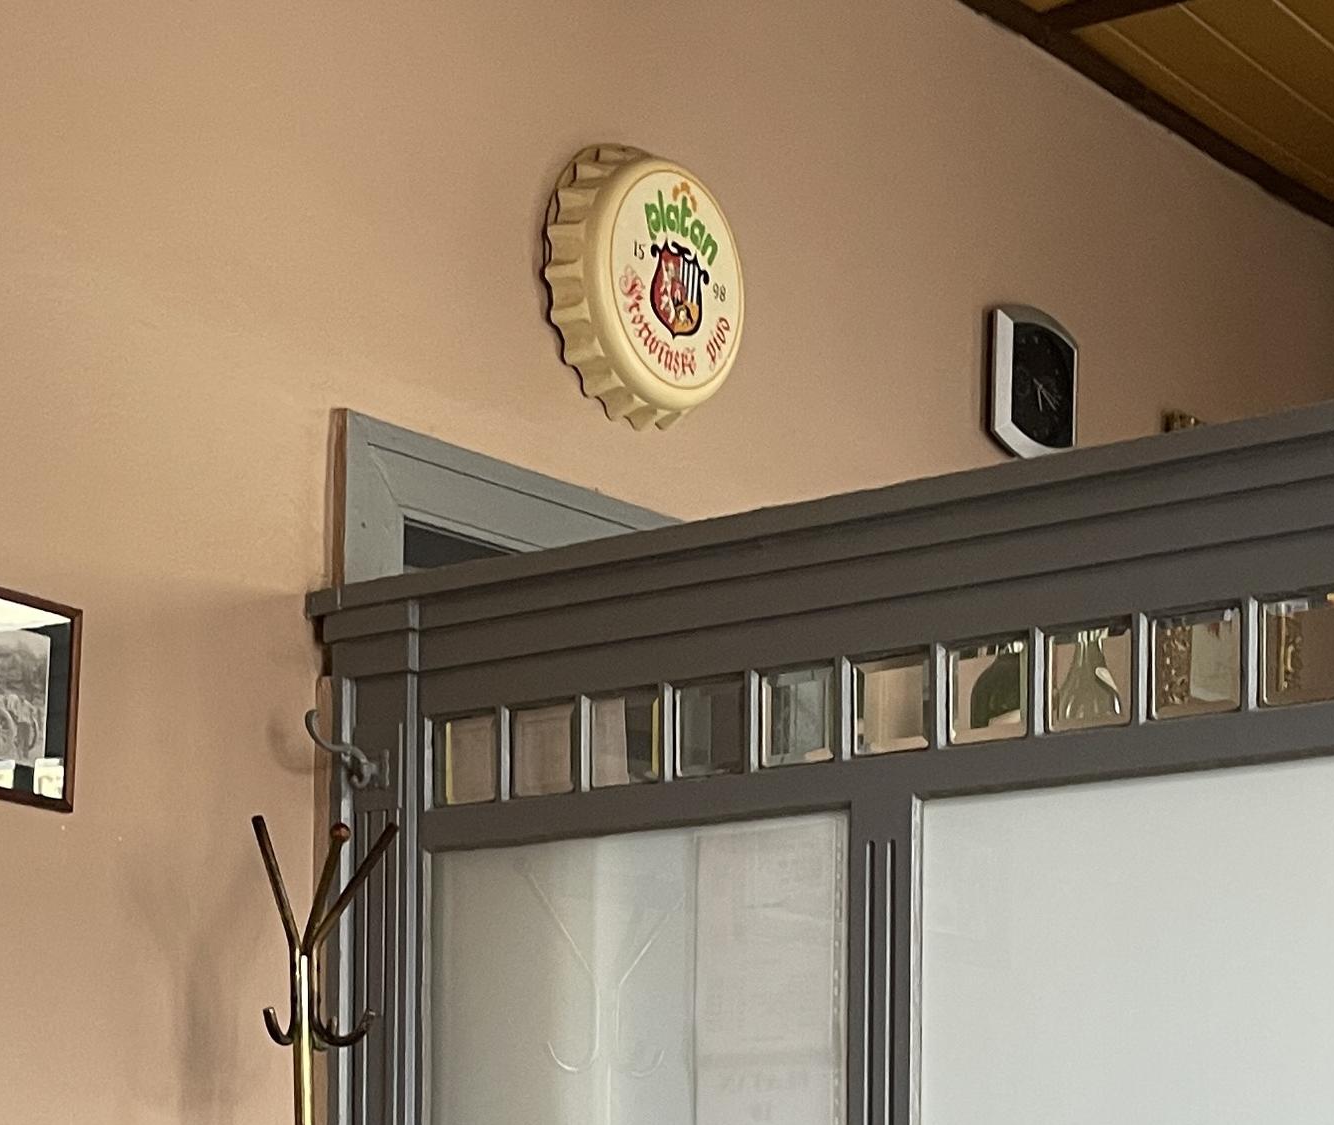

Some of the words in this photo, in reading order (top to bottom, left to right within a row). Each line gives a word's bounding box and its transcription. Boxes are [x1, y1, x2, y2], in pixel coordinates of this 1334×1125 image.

[644, 189, 718, 266] platan
[633, 240, 645, 260] 15
[712, 282, 727, 302] 98
